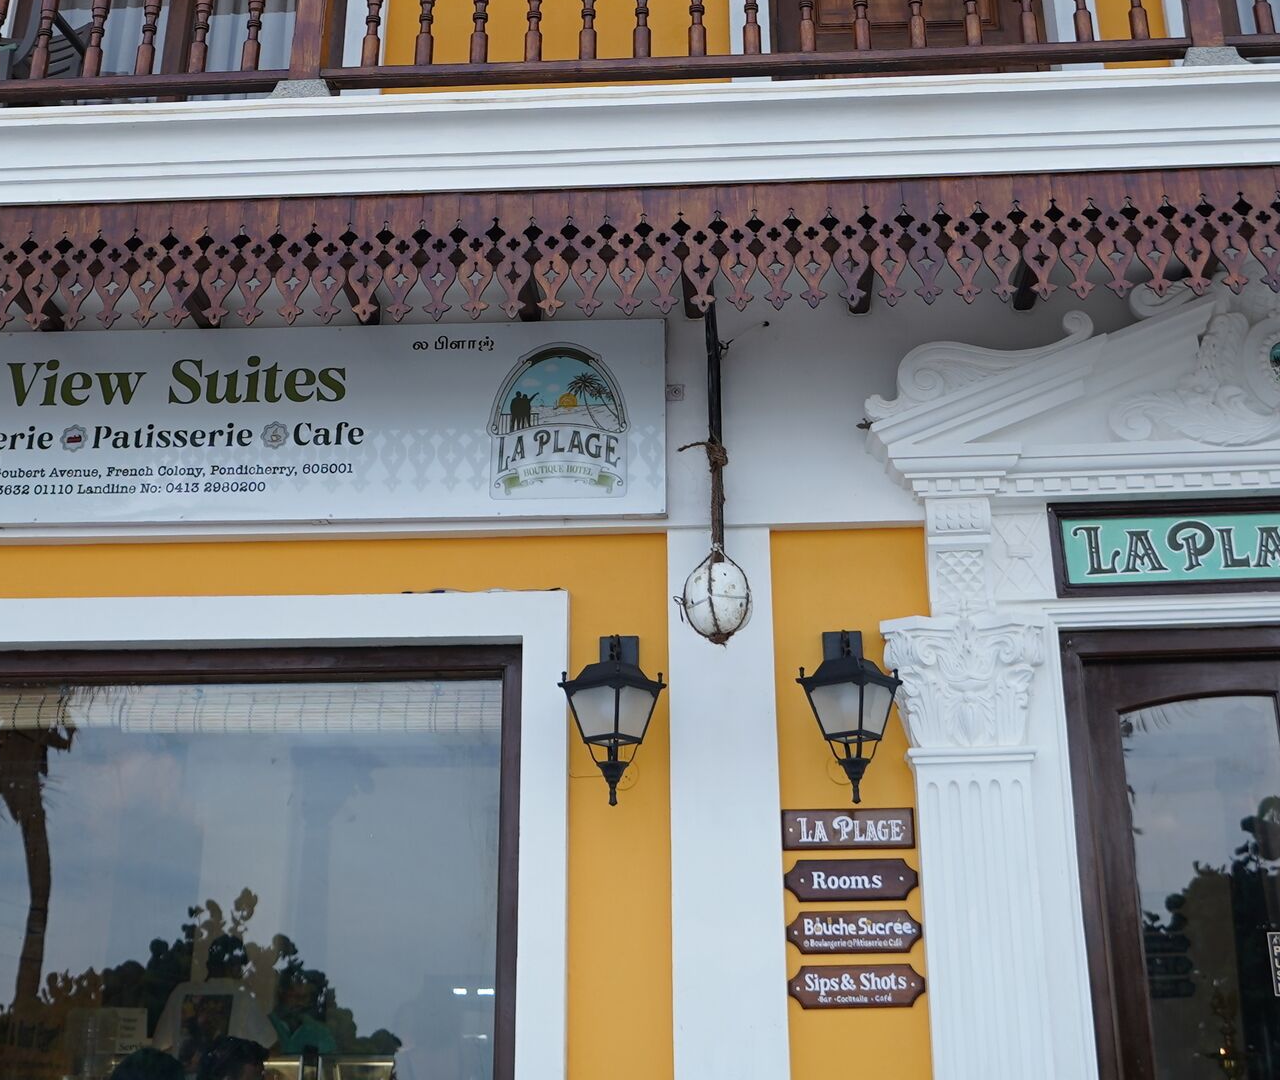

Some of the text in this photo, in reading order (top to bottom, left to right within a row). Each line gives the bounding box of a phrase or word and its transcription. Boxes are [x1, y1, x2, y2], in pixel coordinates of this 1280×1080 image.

[7, 359, 147, 407] View
[168, 355, 347, 405] Suites
[92, 422, 253, 449] Patisserie
[293, 421, 364, 446] Cafe
[496, 430, 620, 473] LA PLAGE
[49, 467, 101, 480] Avenue,
[106, 466, 153, 477] French
[158, 465, 206, 478] Colony,
[210, 464, 298, 477] Pondicherry,
[523, 464, 593, 477] BOUTIQUE HOTEL
[33, 484, 73, 495] 01110
[77, 483, 136, 495] Landline
[140, 483, 161, 494] No:
[165, 482, 199, 493] 0413
[203, 481, 266, 493] 2980200
[1071, 523, 1169, 577] LA
[796, 815, 904, 843] LA PLAGE
[812, 871, 882, 889] Rooms
[803, 917, 856, 935] Bouche
[810, 938, 846, 949] Boulangerie
[805, 973, 838, 995] Sips
[860, 972, 907, 991] Shots
[819, 995, 831, 1003] Bar
